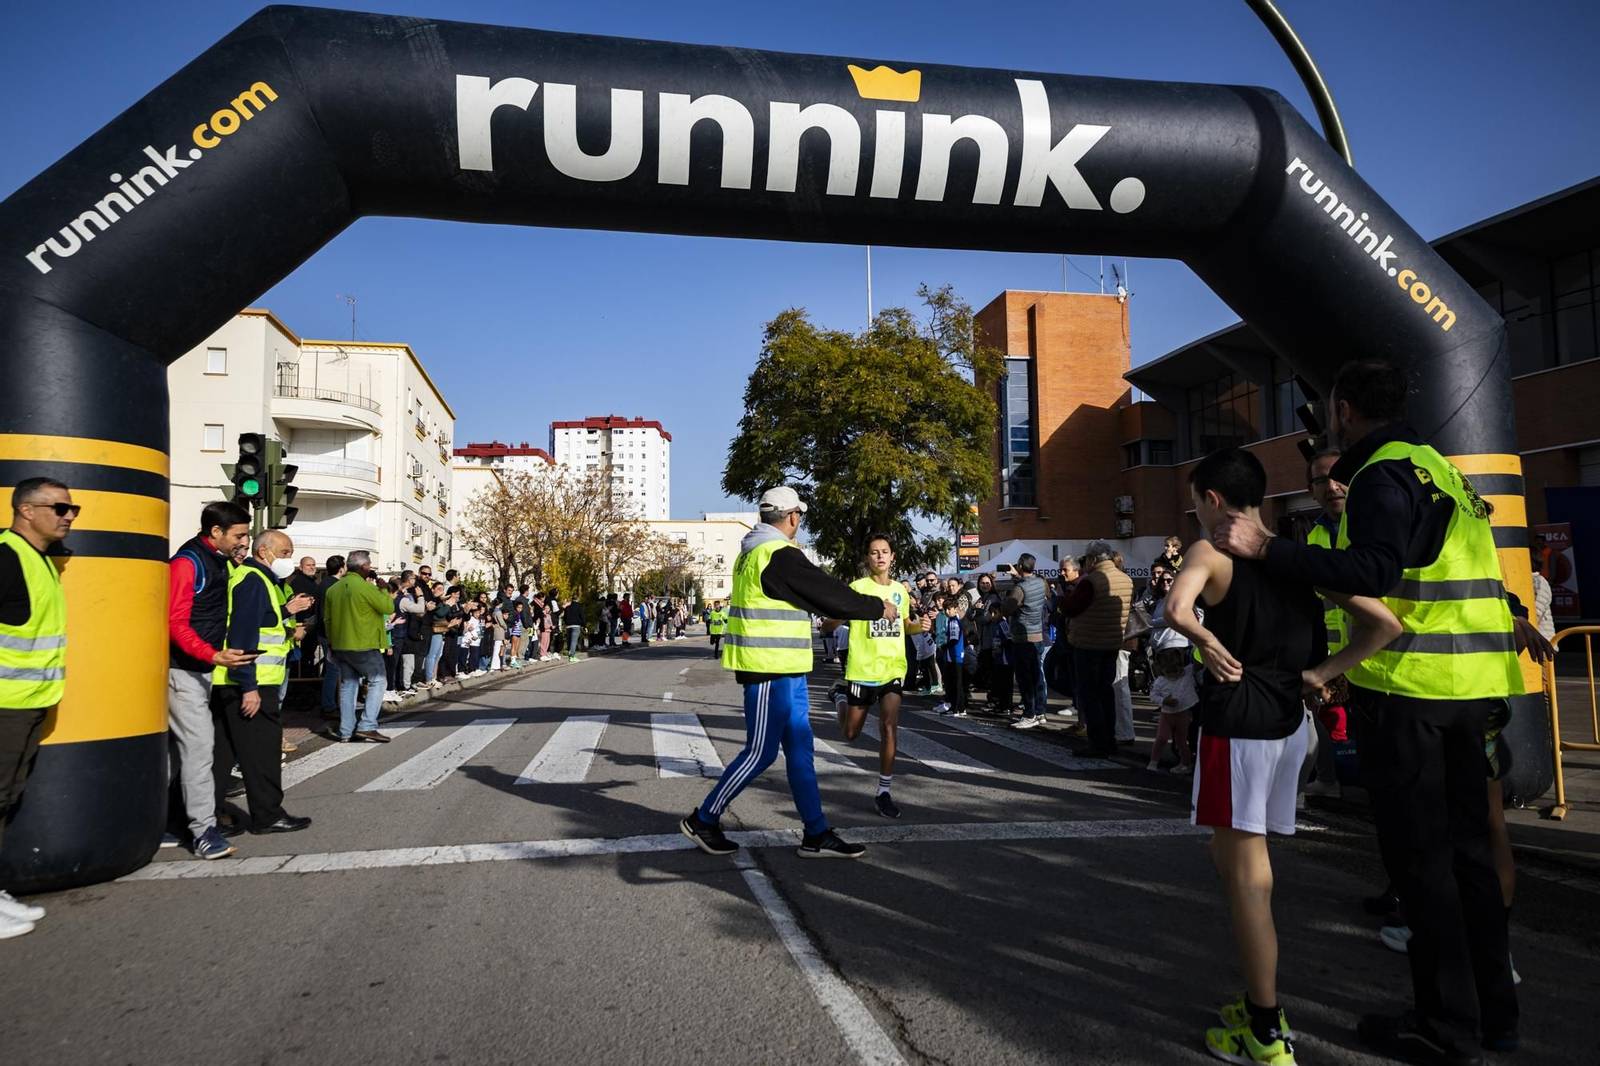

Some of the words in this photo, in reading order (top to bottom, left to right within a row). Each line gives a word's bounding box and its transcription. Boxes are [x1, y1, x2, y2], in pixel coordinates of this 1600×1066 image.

[25, 80, 278, 275] runnink.com
[456, 66, 1146, 214] runnink.
[1285, 156, 1457, 333] runnink.com
